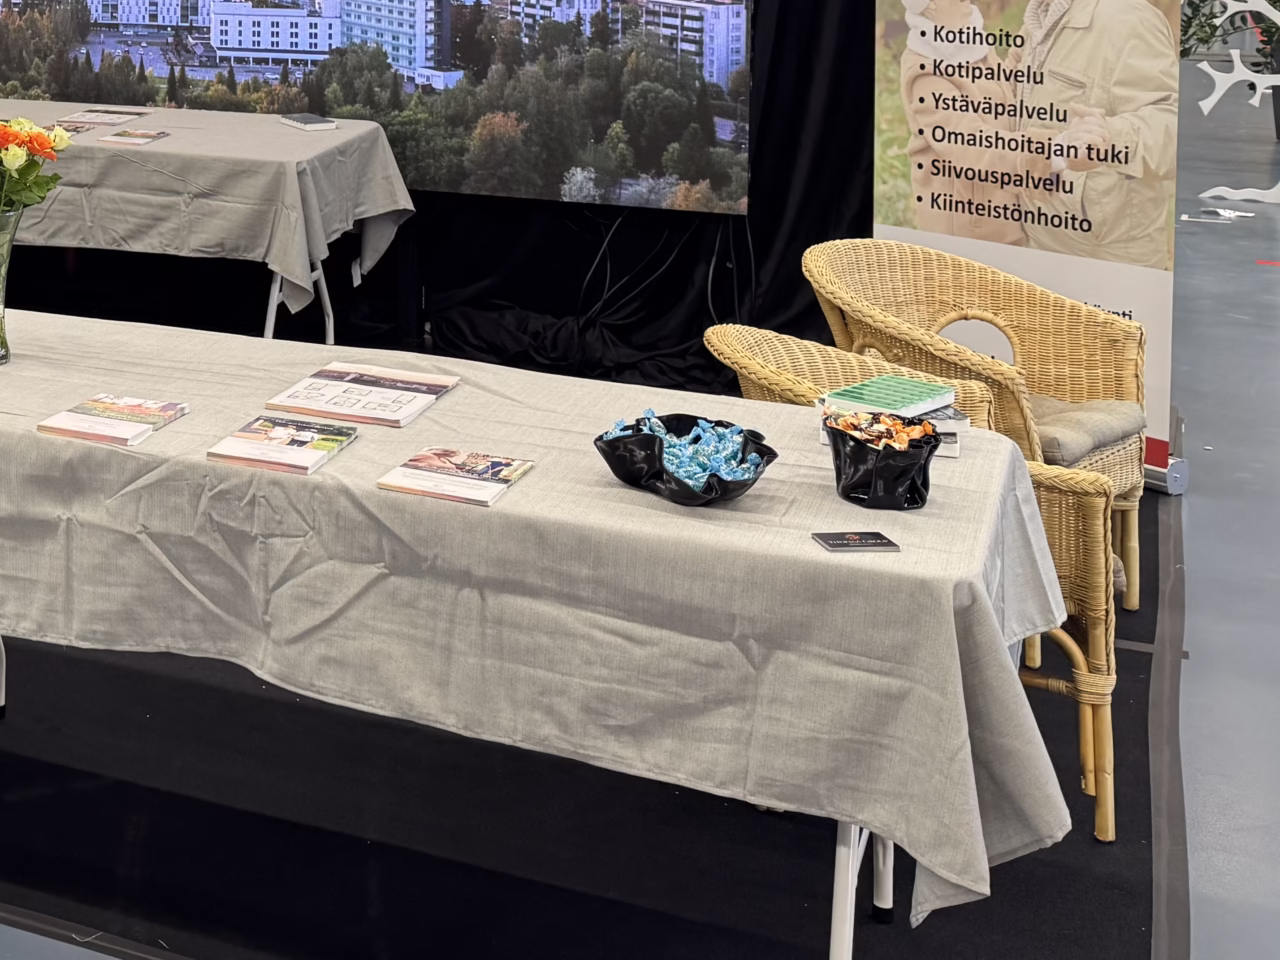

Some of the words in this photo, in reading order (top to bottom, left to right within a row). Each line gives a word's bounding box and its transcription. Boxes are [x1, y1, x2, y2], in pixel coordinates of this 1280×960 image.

[933, 25, 1025, 49] Kotihoito
[932, 58, 1045, 86] Kotipalvelu
[931, 92, 1068, 124] Ystäväpalvelu
[931, 125, 1079, 162] Omaishoitajan
[1085, 141, 1130, 165] tuki
[930, 158, 1075, 195] Siivouspalvelu
[930, 192, 1093, 233] Kiinteistönhoito
